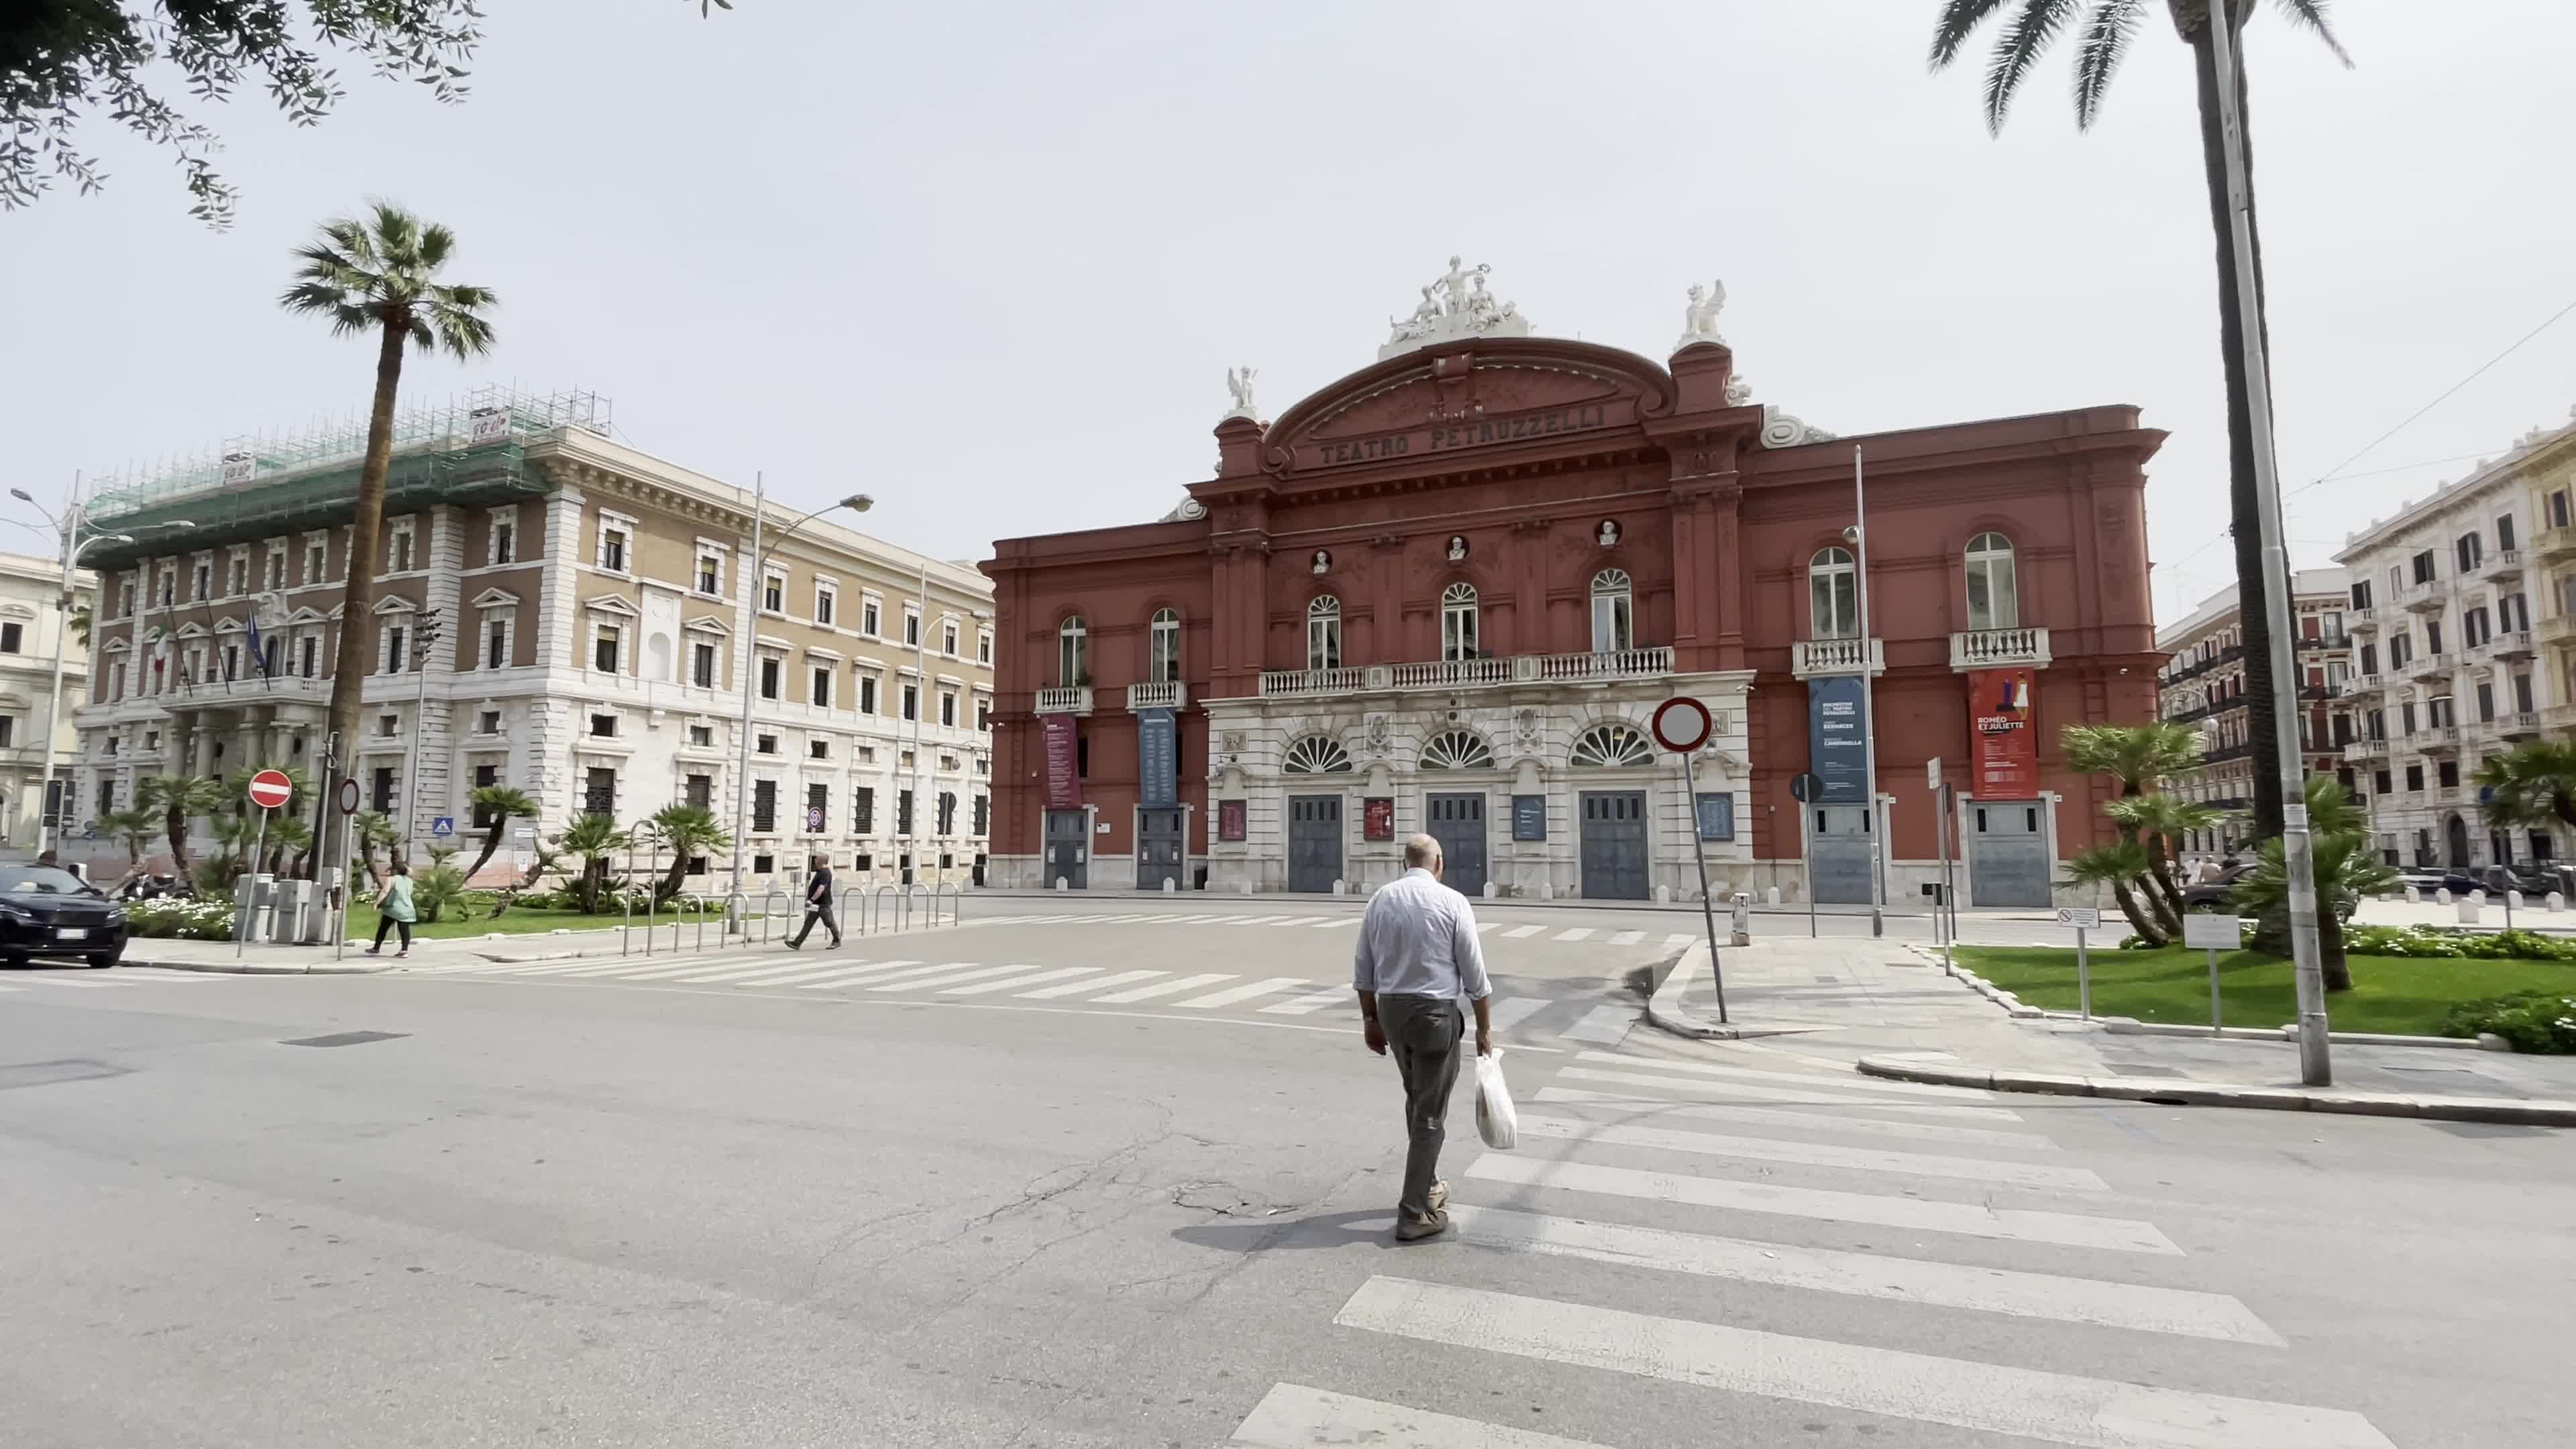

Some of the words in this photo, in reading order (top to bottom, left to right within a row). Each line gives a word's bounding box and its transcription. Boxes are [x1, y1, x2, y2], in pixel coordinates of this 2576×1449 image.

[1320, 435, 1407, 464] TEATRO
[1430, 406, 1604, 449] PETRUZZELLI
[1989, 722, 2024, 730] JULIETTE
